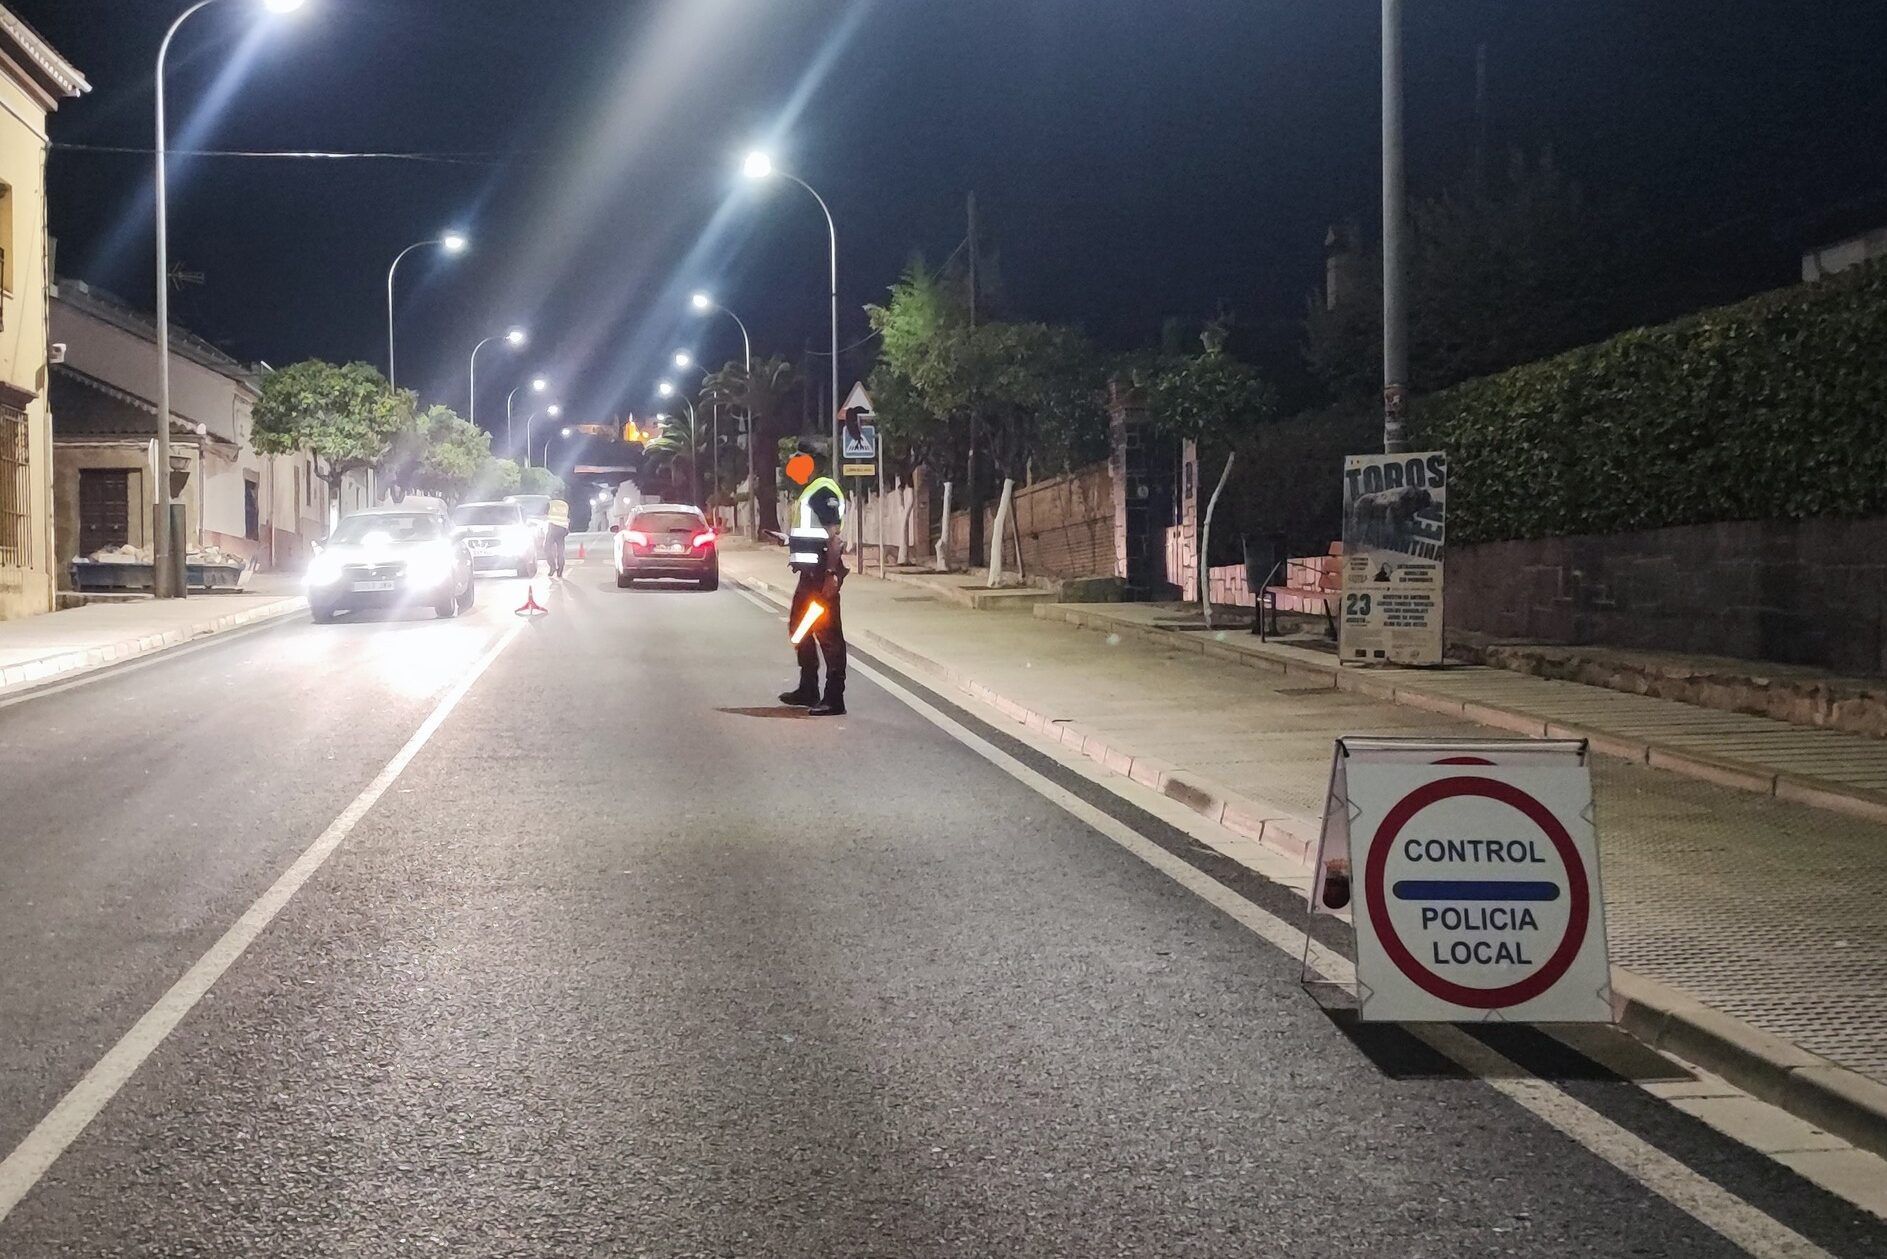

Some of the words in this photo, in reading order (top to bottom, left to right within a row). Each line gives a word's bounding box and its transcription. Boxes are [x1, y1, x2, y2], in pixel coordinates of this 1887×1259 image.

[1345, 454, 1446, 500] TOROS
[1346, 592, 1372, 616] 23
[1404, 839, 1546, 863] CONTROL
[1421, 907, 1538, 931] POLICIA
[1433, 941, 1533, 965] LOCAL
